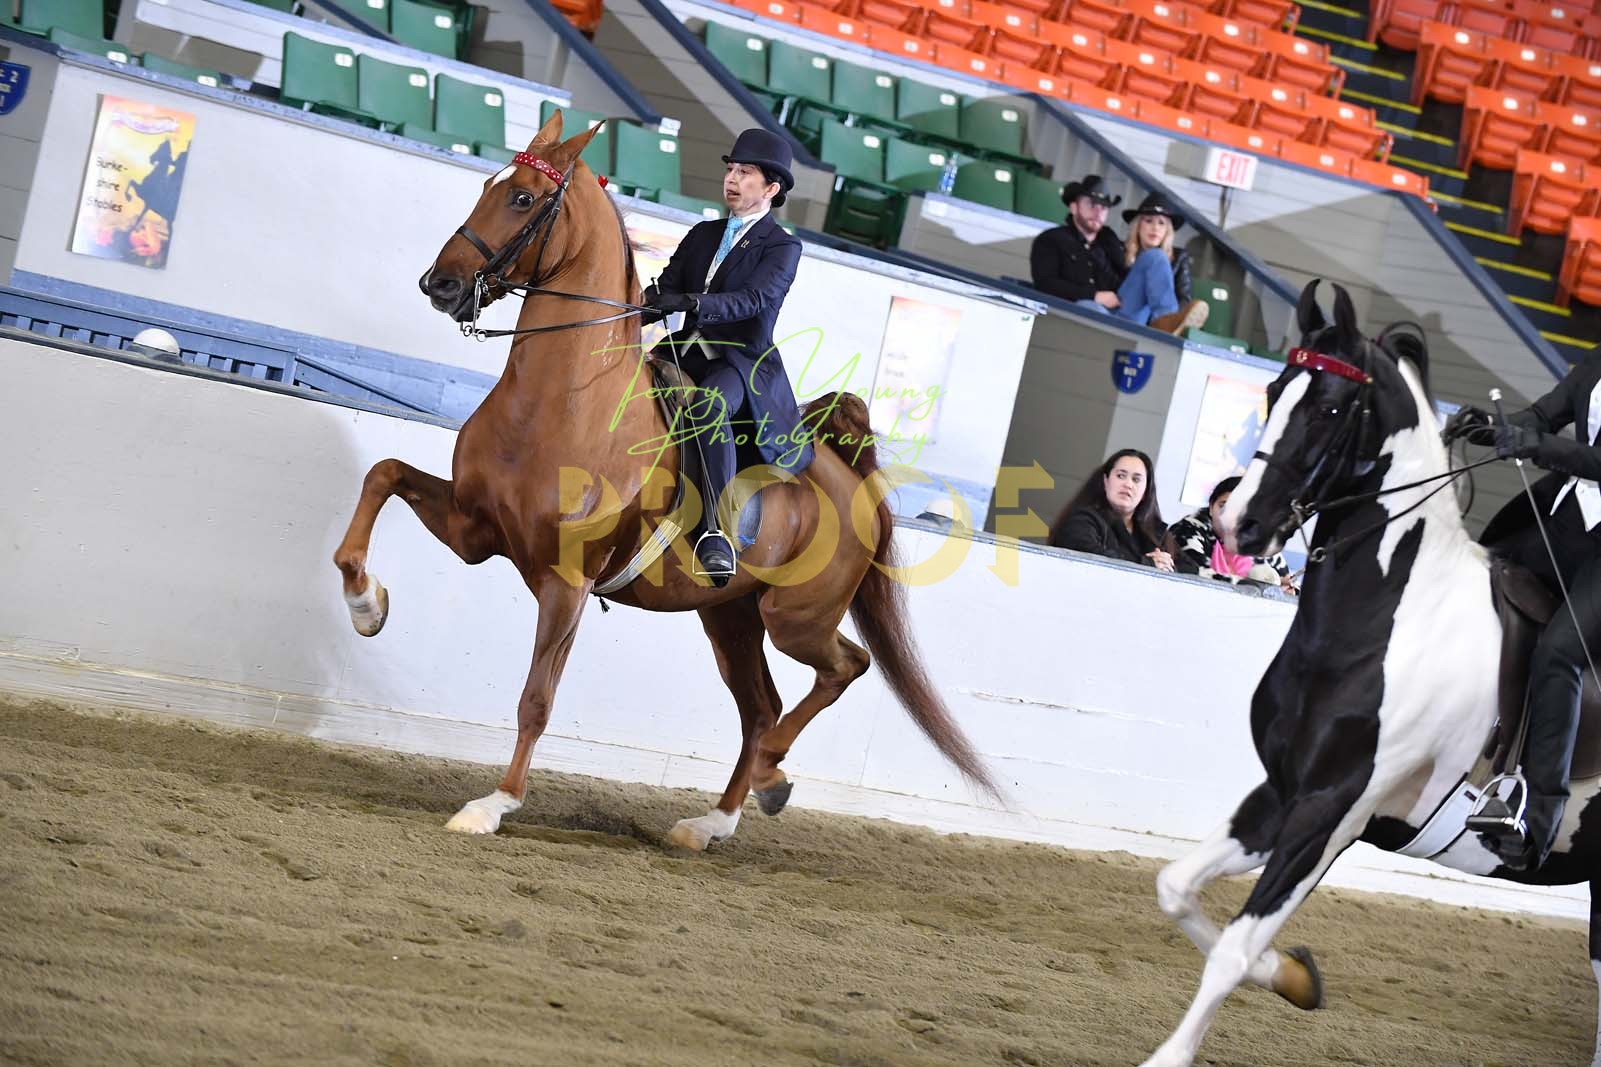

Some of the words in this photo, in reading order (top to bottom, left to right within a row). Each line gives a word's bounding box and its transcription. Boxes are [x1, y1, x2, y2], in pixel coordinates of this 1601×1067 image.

[10, 70, 19, 83] 2
[1215, 152, 1251, 185] EXIT
[87, 196, 124, 213] Stables
[1137, 356, 1145, 368] 3
